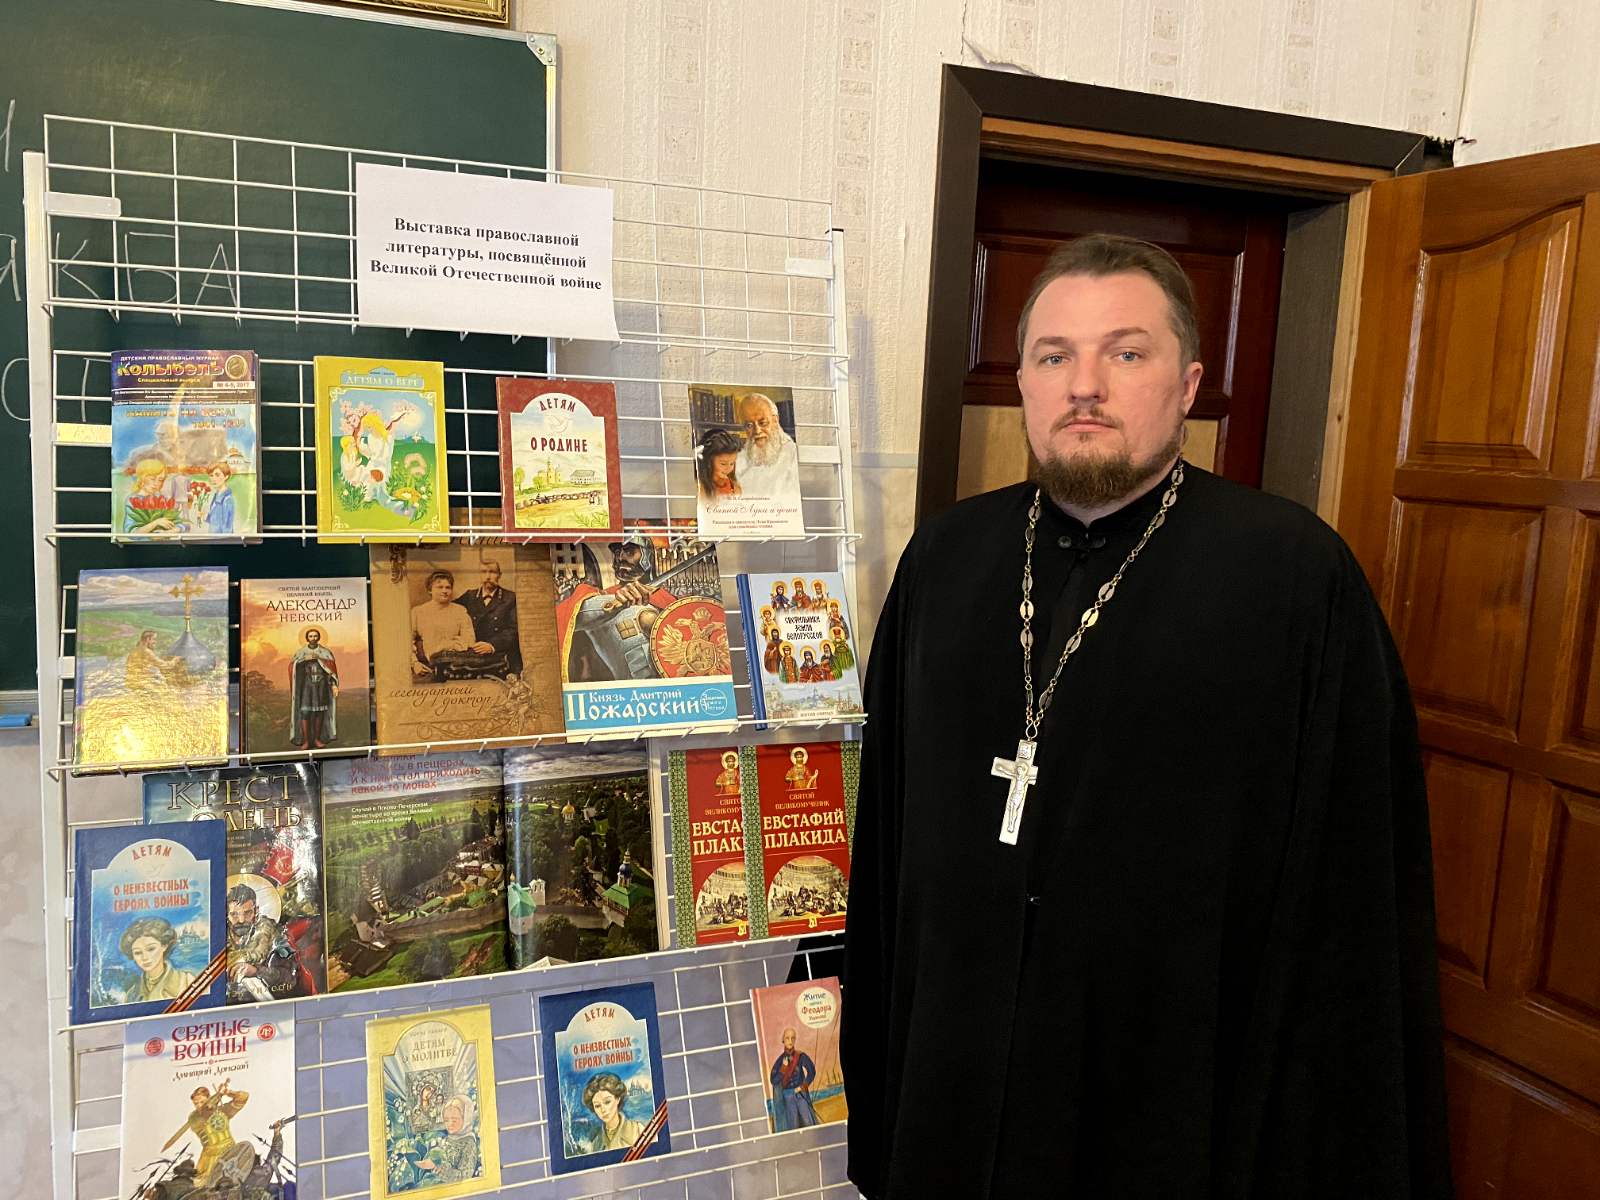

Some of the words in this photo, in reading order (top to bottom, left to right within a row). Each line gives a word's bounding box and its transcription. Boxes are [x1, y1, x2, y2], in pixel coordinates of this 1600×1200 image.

[395, 217, 471, 237] Выставка
[476, 226, 579, 247] православной
[385, 242, 484, 261] литературы,
[488, 250, 587, 268] посвящённой
[370, 260, 437, 277] Великой
[442, 265, 555, 286] Отечественной
[560, 277, 602, 290] войне
[539, 398, 575, 412] ДЕТЯМ
[531, 437, 537, 450] О
[541, 438, 588, 452] РОДИНЕ
[266, 598, 357, 611] АЛЕКСАНДР
[280, 611, 343, 622] НЕВСКИЙ
[589, 692, 625, 704] Князь
[630, 688, 682, 703] Дмитрий
[434, 695, 492, 716] доктор
[567, 693, 700, 723] Пожарский
[423, 768, 481, 780] приходить
[168, 774, 301, 811] КРЕСТ
[402, 782, 437, 791] монах
[789, 791, 815, 801] СВЯТОЙ
[763, 808, 845, 830] ЕВСТАФИЙ
[764, 829, 846, 849] ПЛАКИДА
[131, 845, 172, 861] ДЕТЯМ
[114, 885, 120, 896] О
[123, 878, 189, 896] НЕИЗВЕСТНЫХ
[114, 896, 150, 912] ГЕРОЯХ
[154, 893, 190, 908] ВОЙНЫ
[584, 1007, 615, 1023] ДЕТЯМ
[801, 1005, 832, 1014] Феодора
[171, 1018, 252, 1043] СВЯТЫЕ
[171, 1038, 248, 1061] ВОИНЫ
[413, 1038, 446, 1052] ДЕТЯМ
[573, 1046, 578, 1055] О
[581, 1037, 632, 1054] НЕИЗВЕСТНЫХ
[401, 1055, 409, 1064] О
[412, 1048, 458, 1064] МОЛИТВЕ
[574, 1056, 604, 1070] ГЕРОЯХ
[605, 1051, 633, 1065] ВОЙНЫ
